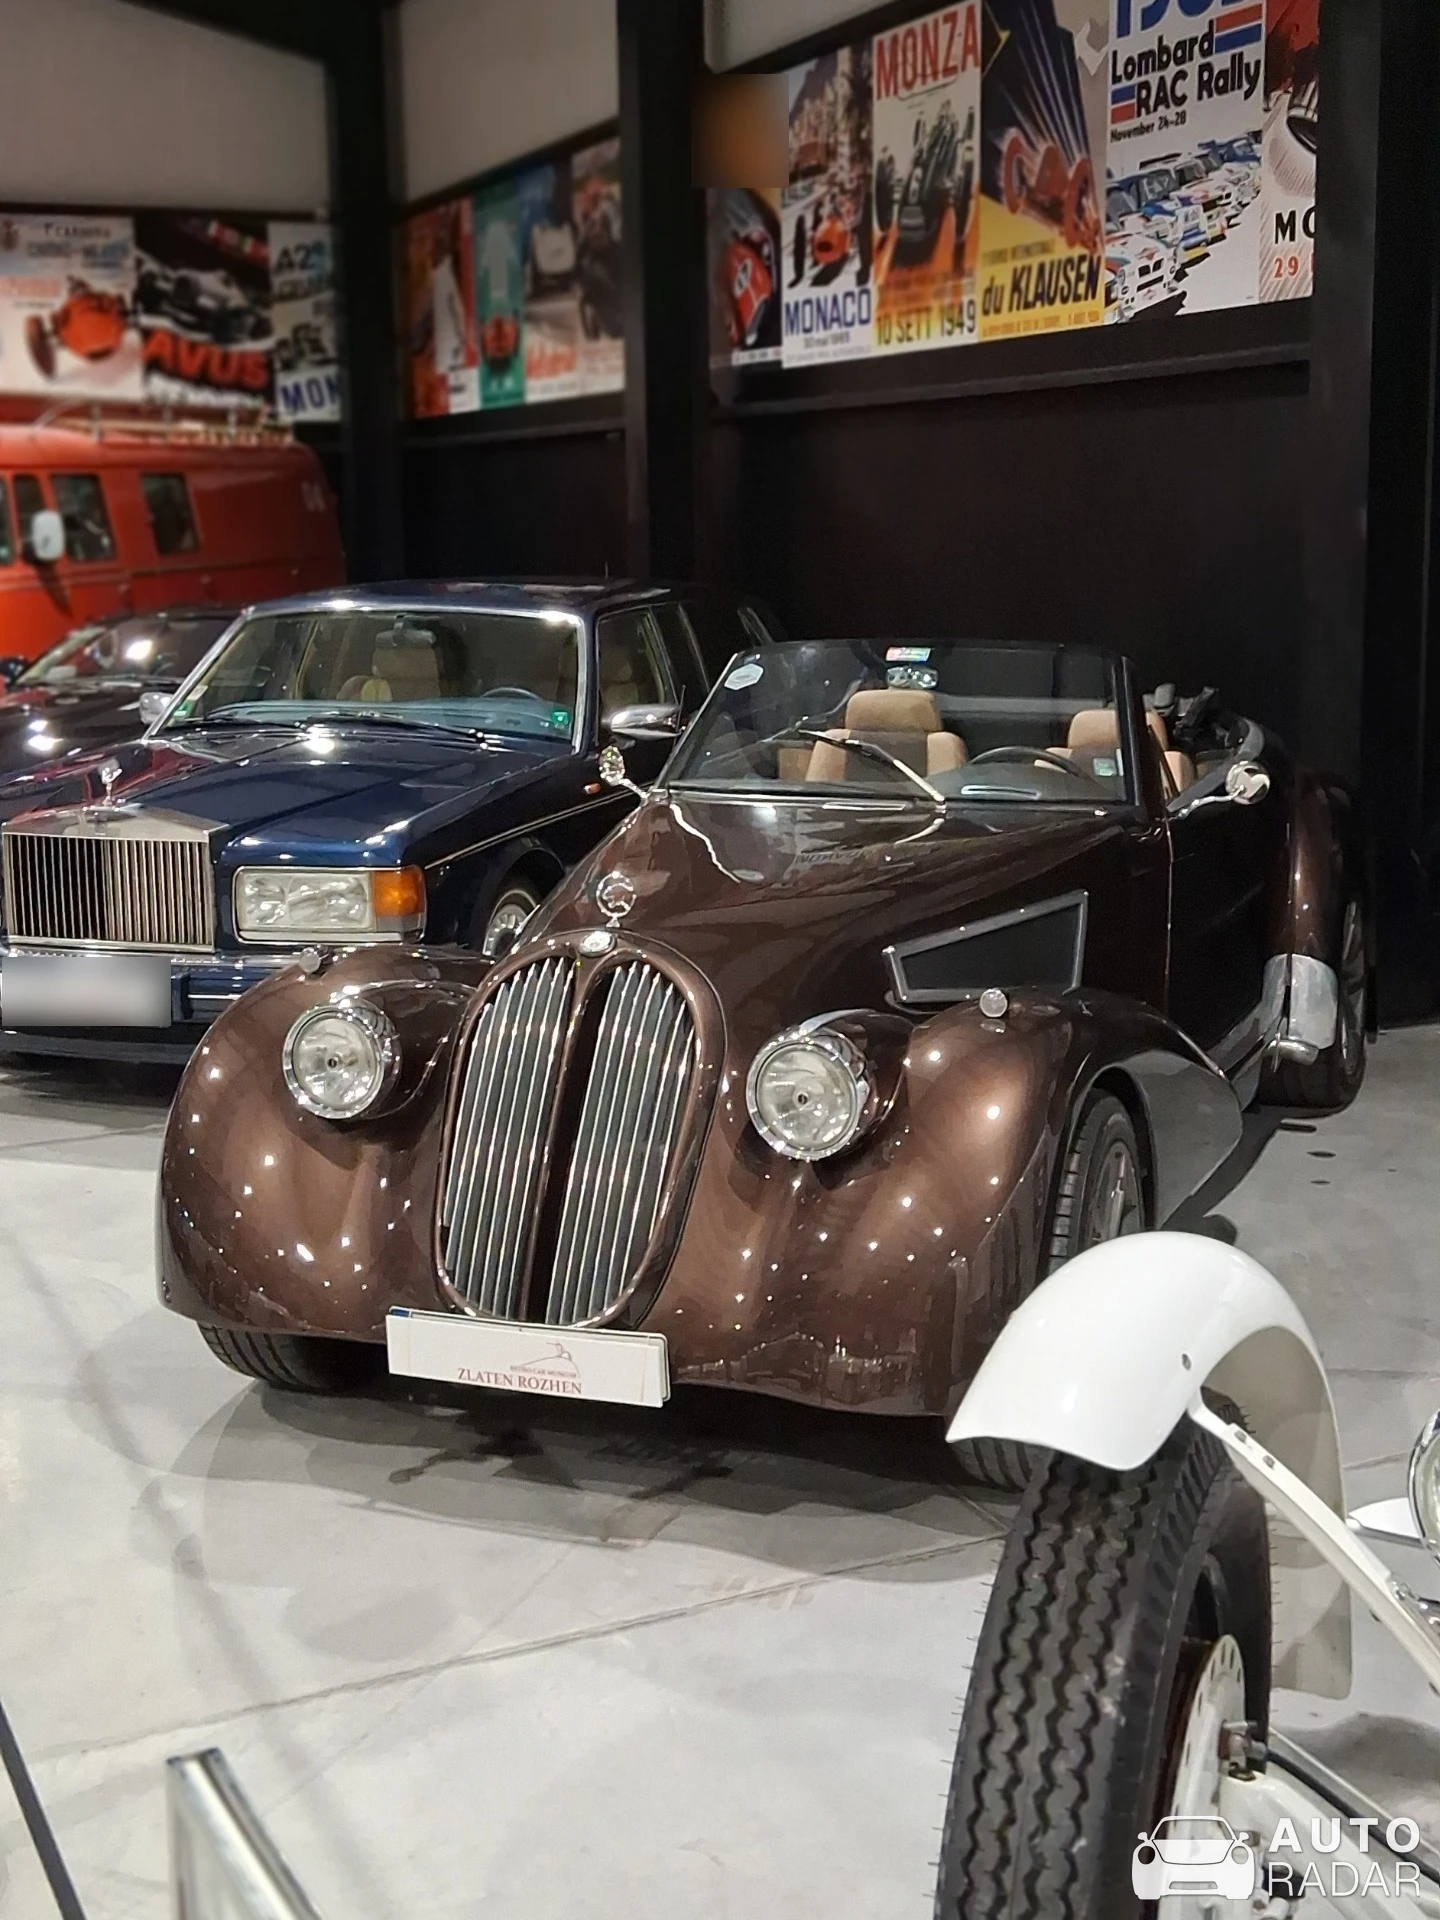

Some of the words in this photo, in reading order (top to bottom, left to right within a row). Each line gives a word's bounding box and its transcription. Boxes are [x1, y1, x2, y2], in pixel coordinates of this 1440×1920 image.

[876, 4, 980, 100] MONZA
[1111, 18, 1214, 85] Lombard
[1136, 69, 1188, 118] RAC
[1197, 51, 1261, 101] Rally
[1110, 121, 1155, 143] November
[982, 274, 1005, 316] du
[1008, 253, 1102, 313] KLAUSEN
[1273, 255, 1299, 278] 29
[785, 288, 871, 336] MONACO
[897, 306, 931, 343] SETT
[941, 299, 976, 337] 1949
[143, 327, 268, 389] AVUS
[457, 1367, 513, 1387] ZLATEN
[518, 1375, 582, 1395] ROZHEN
